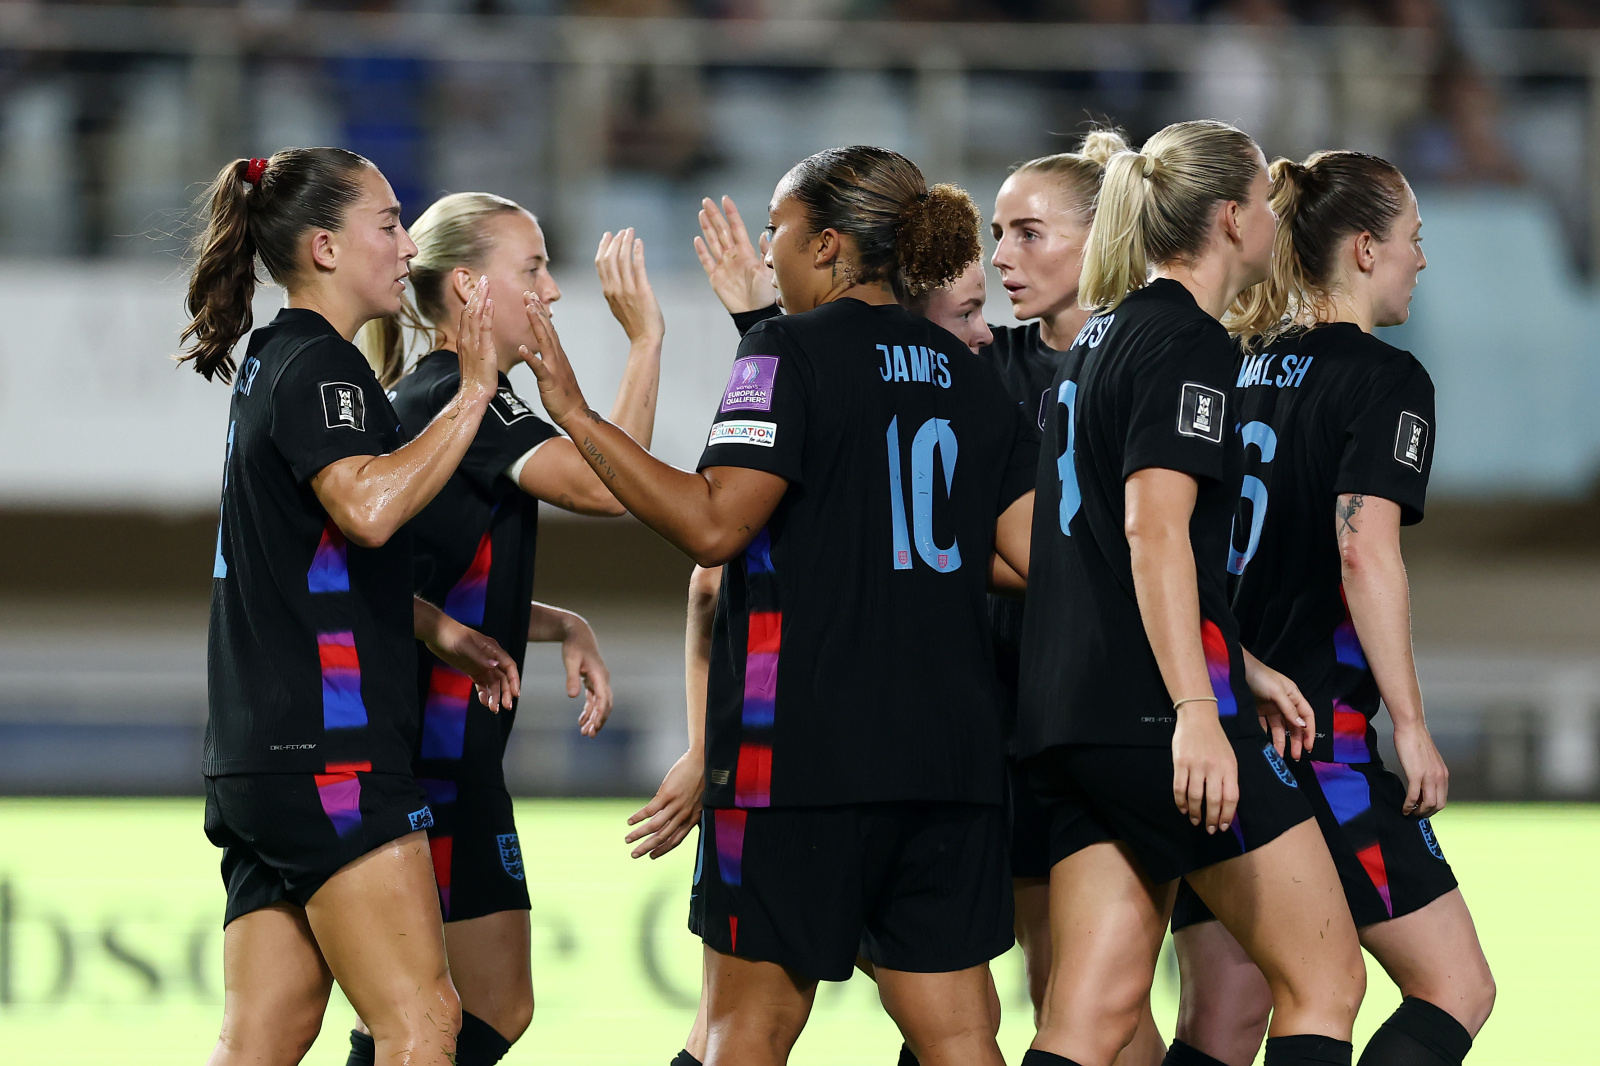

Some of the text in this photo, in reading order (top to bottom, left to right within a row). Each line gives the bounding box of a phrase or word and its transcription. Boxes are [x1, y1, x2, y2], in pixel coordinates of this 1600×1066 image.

[876, 344, 951, 389] JAMES
[1236, 353, 1314, 388] WALSH
[728, 390, 766, 398] EUROPEAN
[726, 397, 766, 405] QUALIFIERS
[712, 428, 773, 438] FOUNDATION
